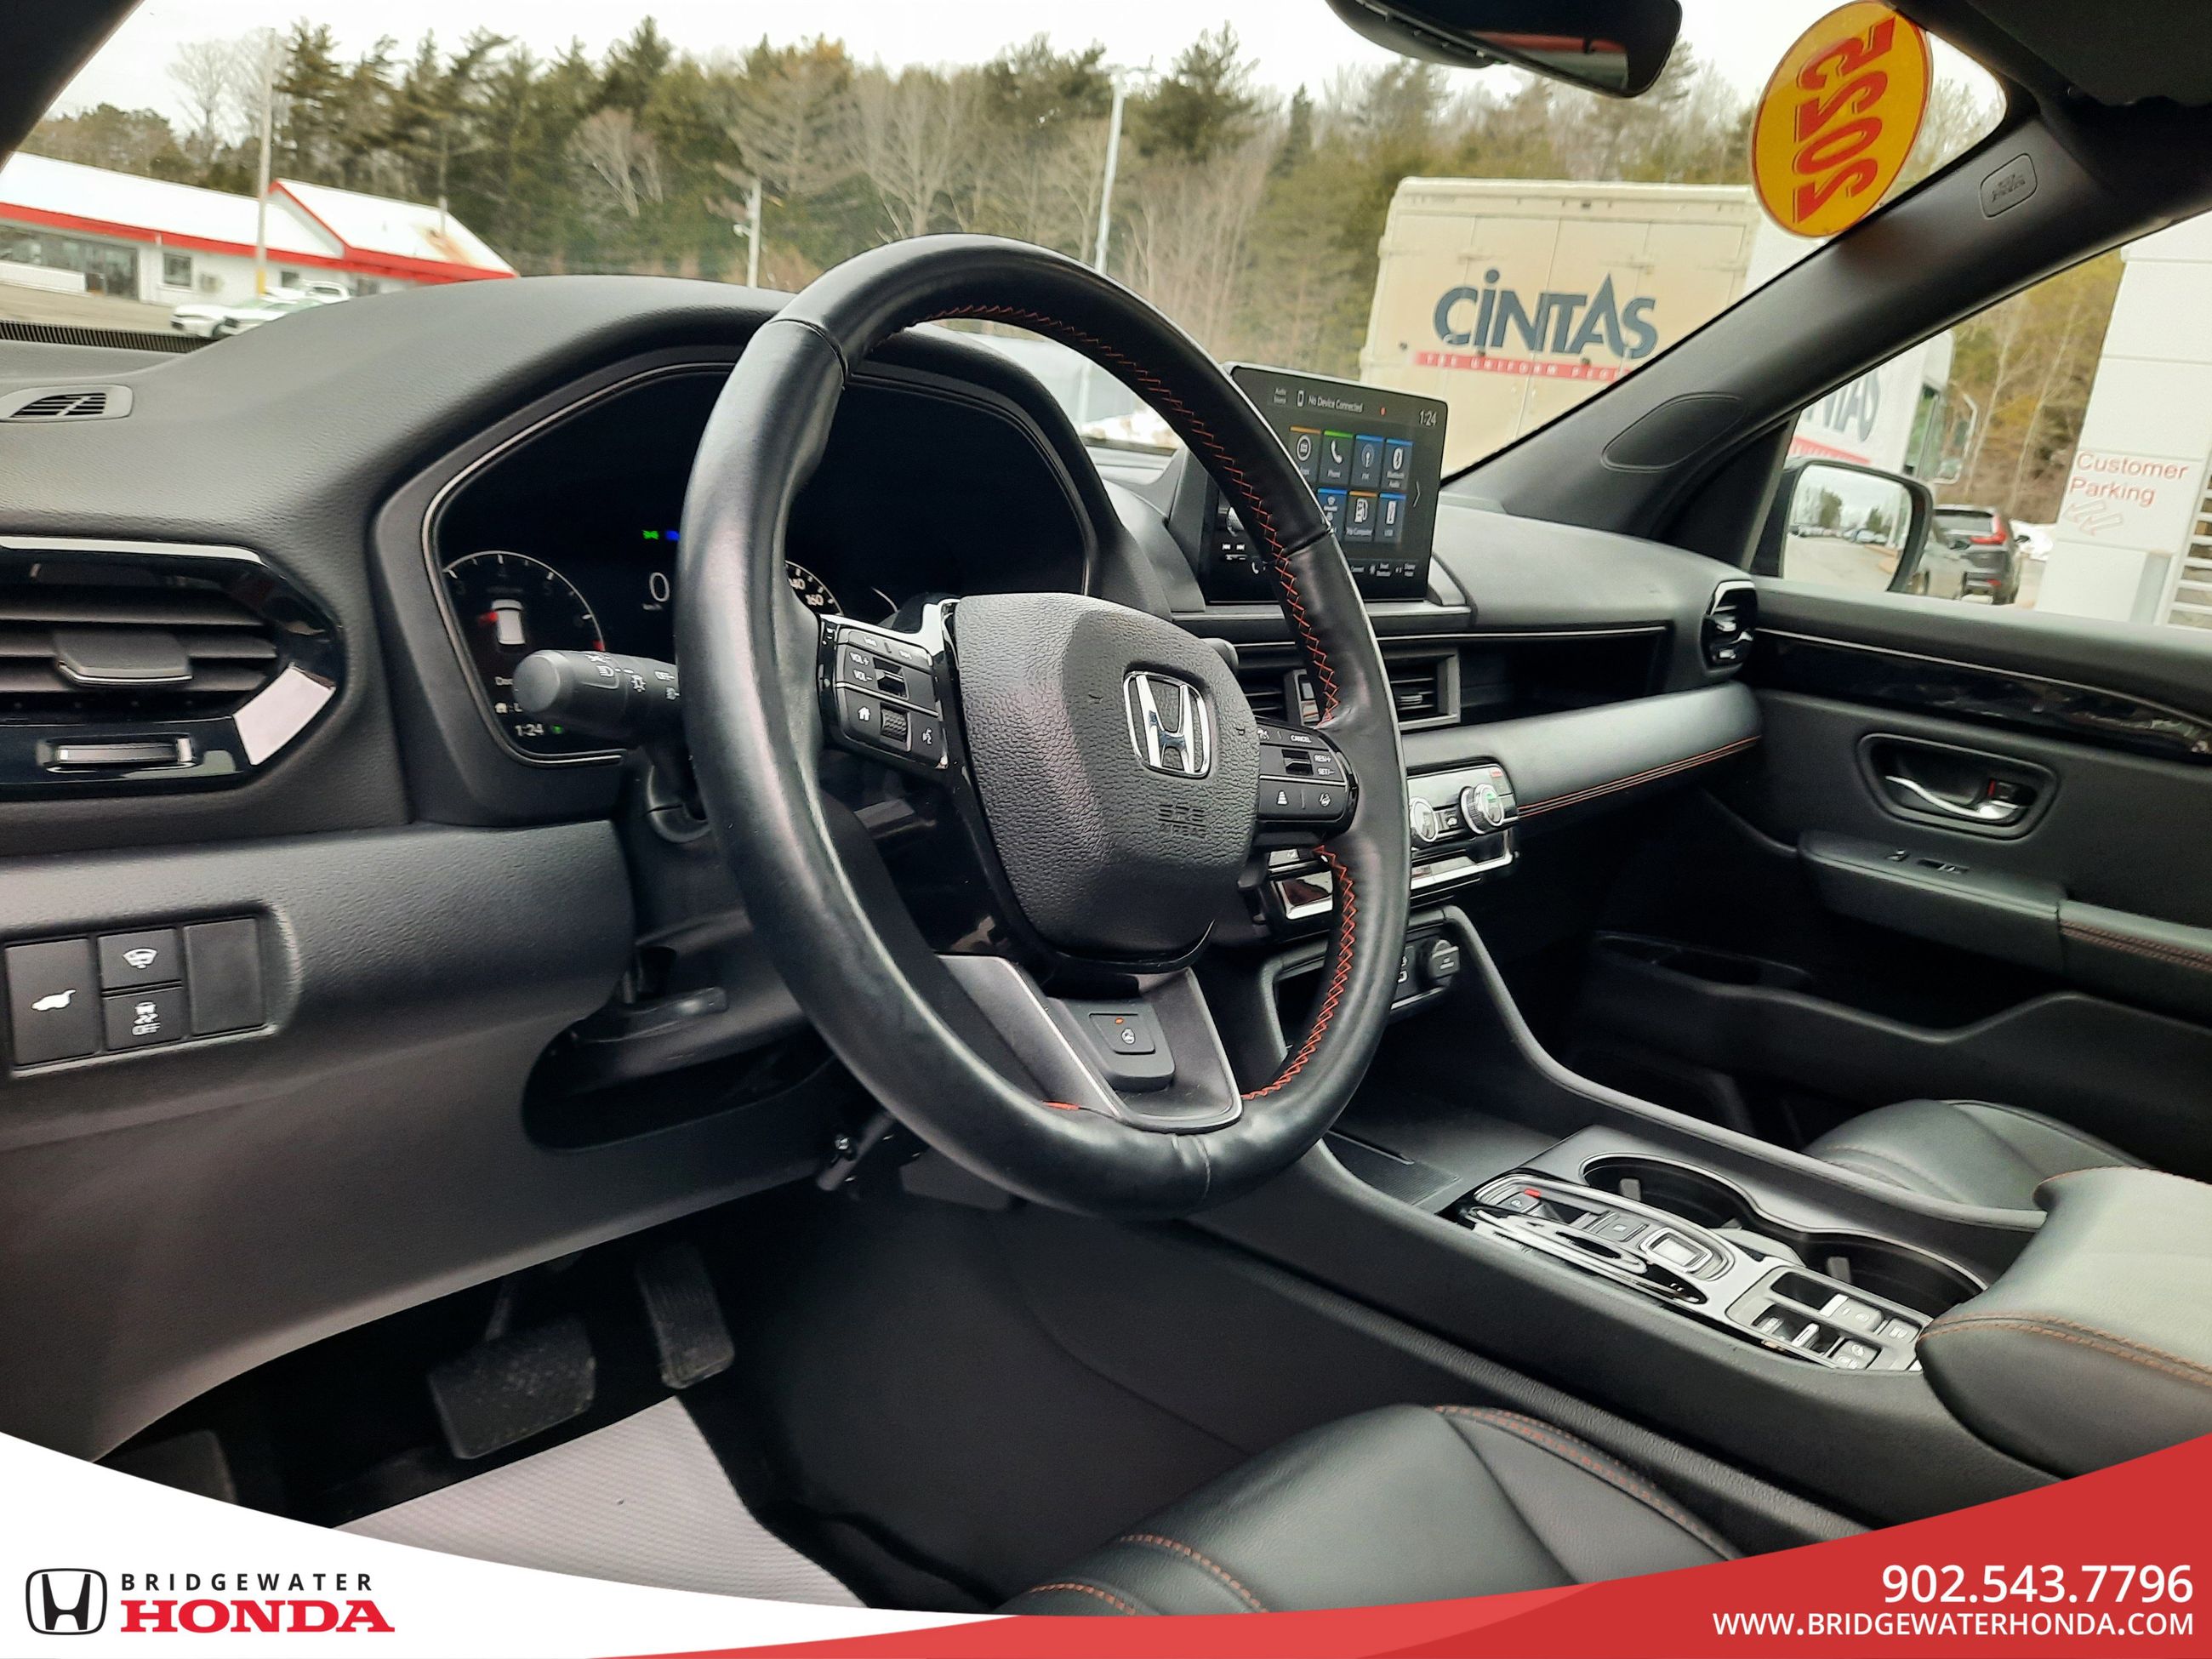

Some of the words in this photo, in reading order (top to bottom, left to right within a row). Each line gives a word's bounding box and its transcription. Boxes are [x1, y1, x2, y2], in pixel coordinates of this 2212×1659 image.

[1308, 395, 1317, 405] No
[1317, 396, 1336, 408] Device
[1336, 399, 1363, 413] Connected
[1420, 410, 1437, 426] 1:24
[2077, 449, 2190, 480] Customer
[2069, 476, 2157, 508] Parking
